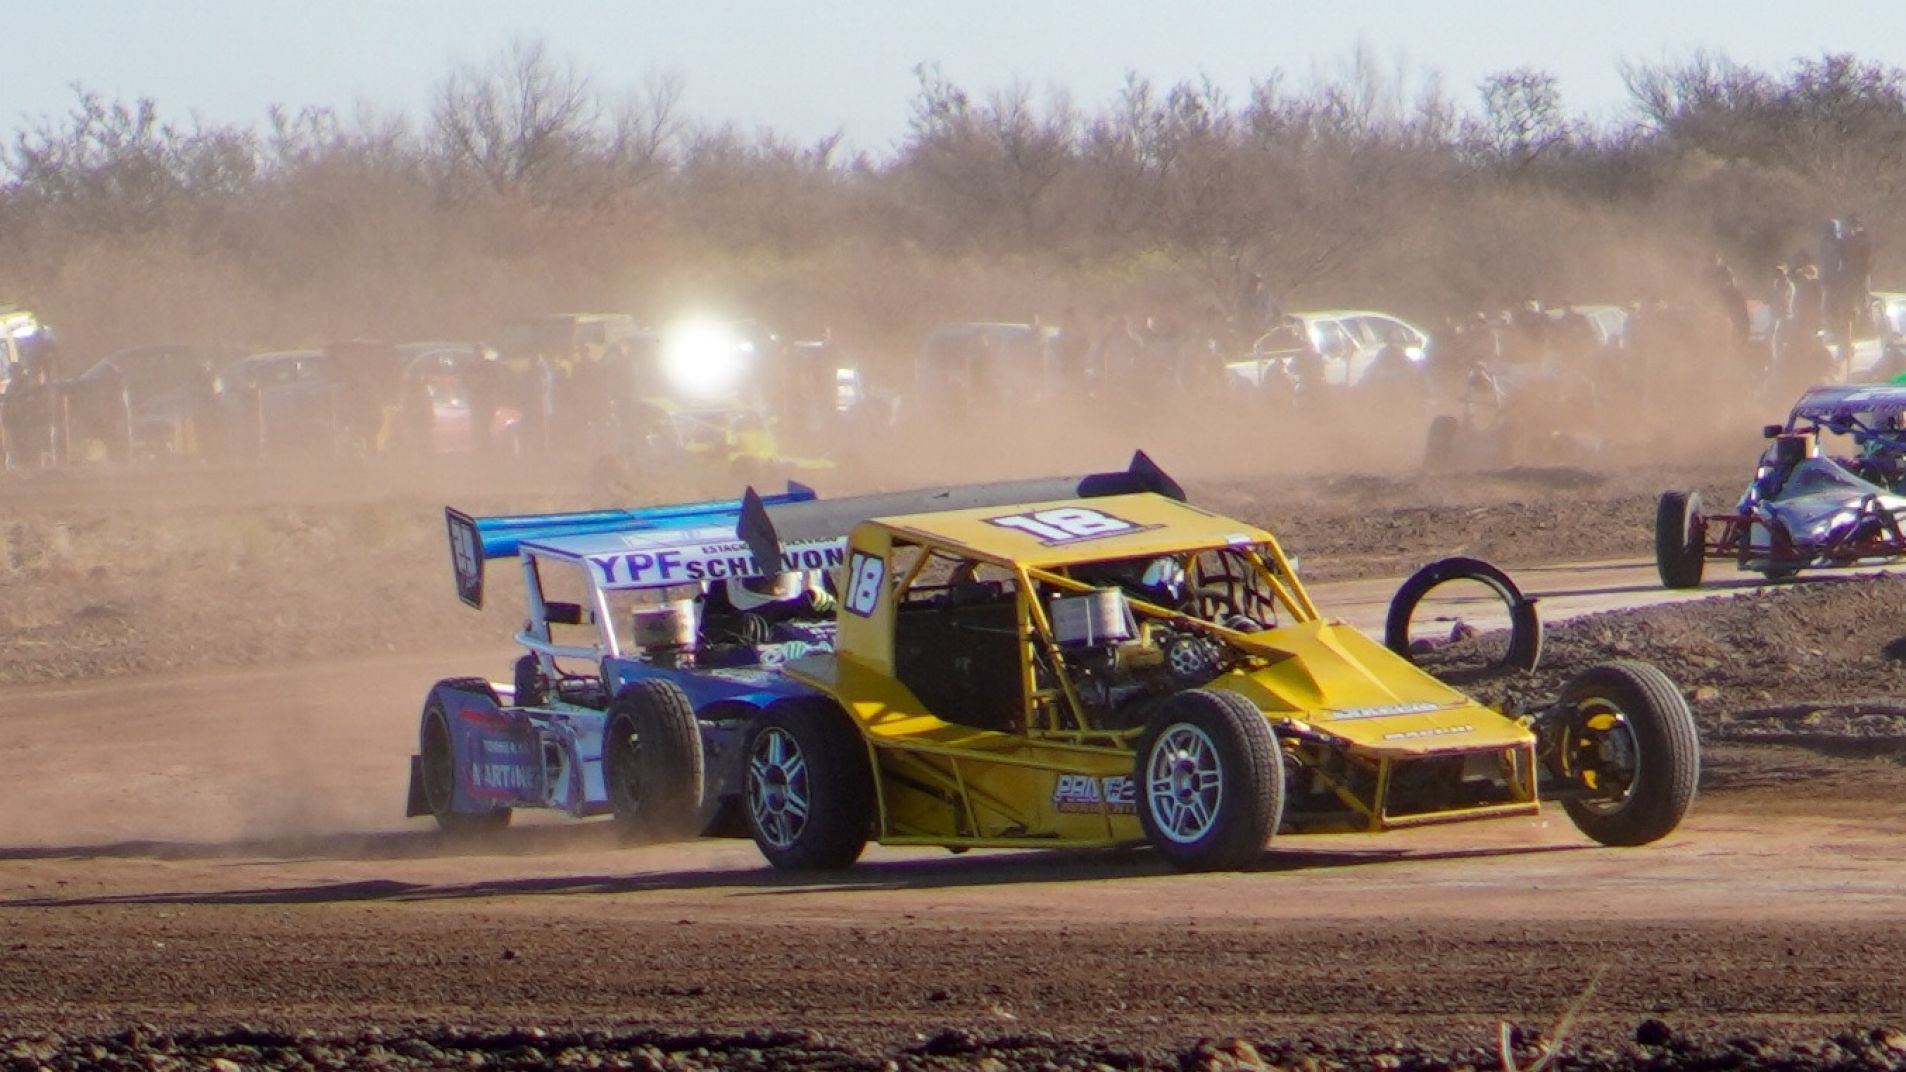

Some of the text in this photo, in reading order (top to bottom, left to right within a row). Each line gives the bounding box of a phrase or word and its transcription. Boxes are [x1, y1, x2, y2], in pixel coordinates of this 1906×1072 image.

[990, 507, 1134, 541] 18
[589, 547, 844, 584] YPF SCHIVON
[845, 553, 883, 614] 18
